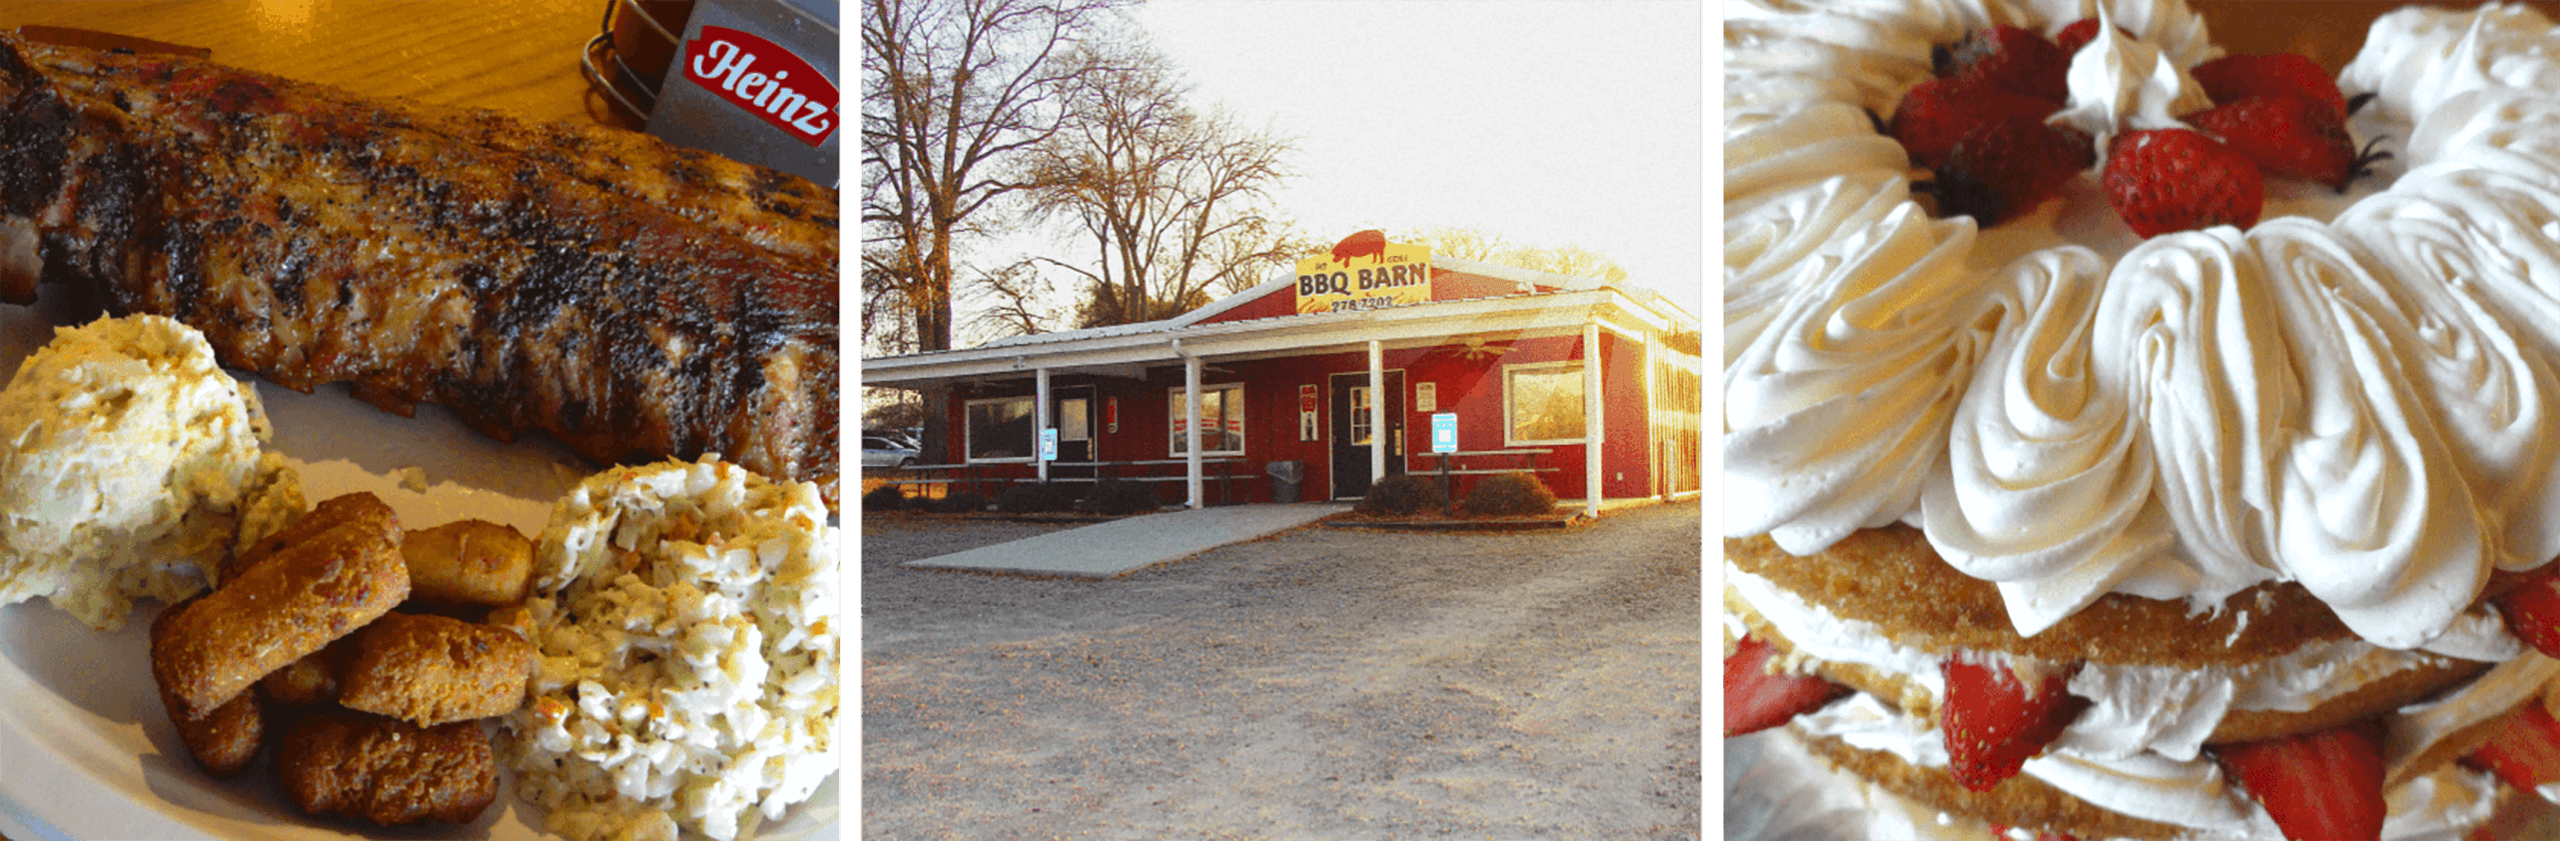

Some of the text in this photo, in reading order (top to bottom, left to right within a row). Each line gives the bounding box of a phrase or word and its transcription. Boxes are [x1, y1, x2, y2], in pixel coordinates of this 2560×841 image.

[693, 39, 830, 136] Heinz
[1298, 262, 1426, 296] BBQ BARN
